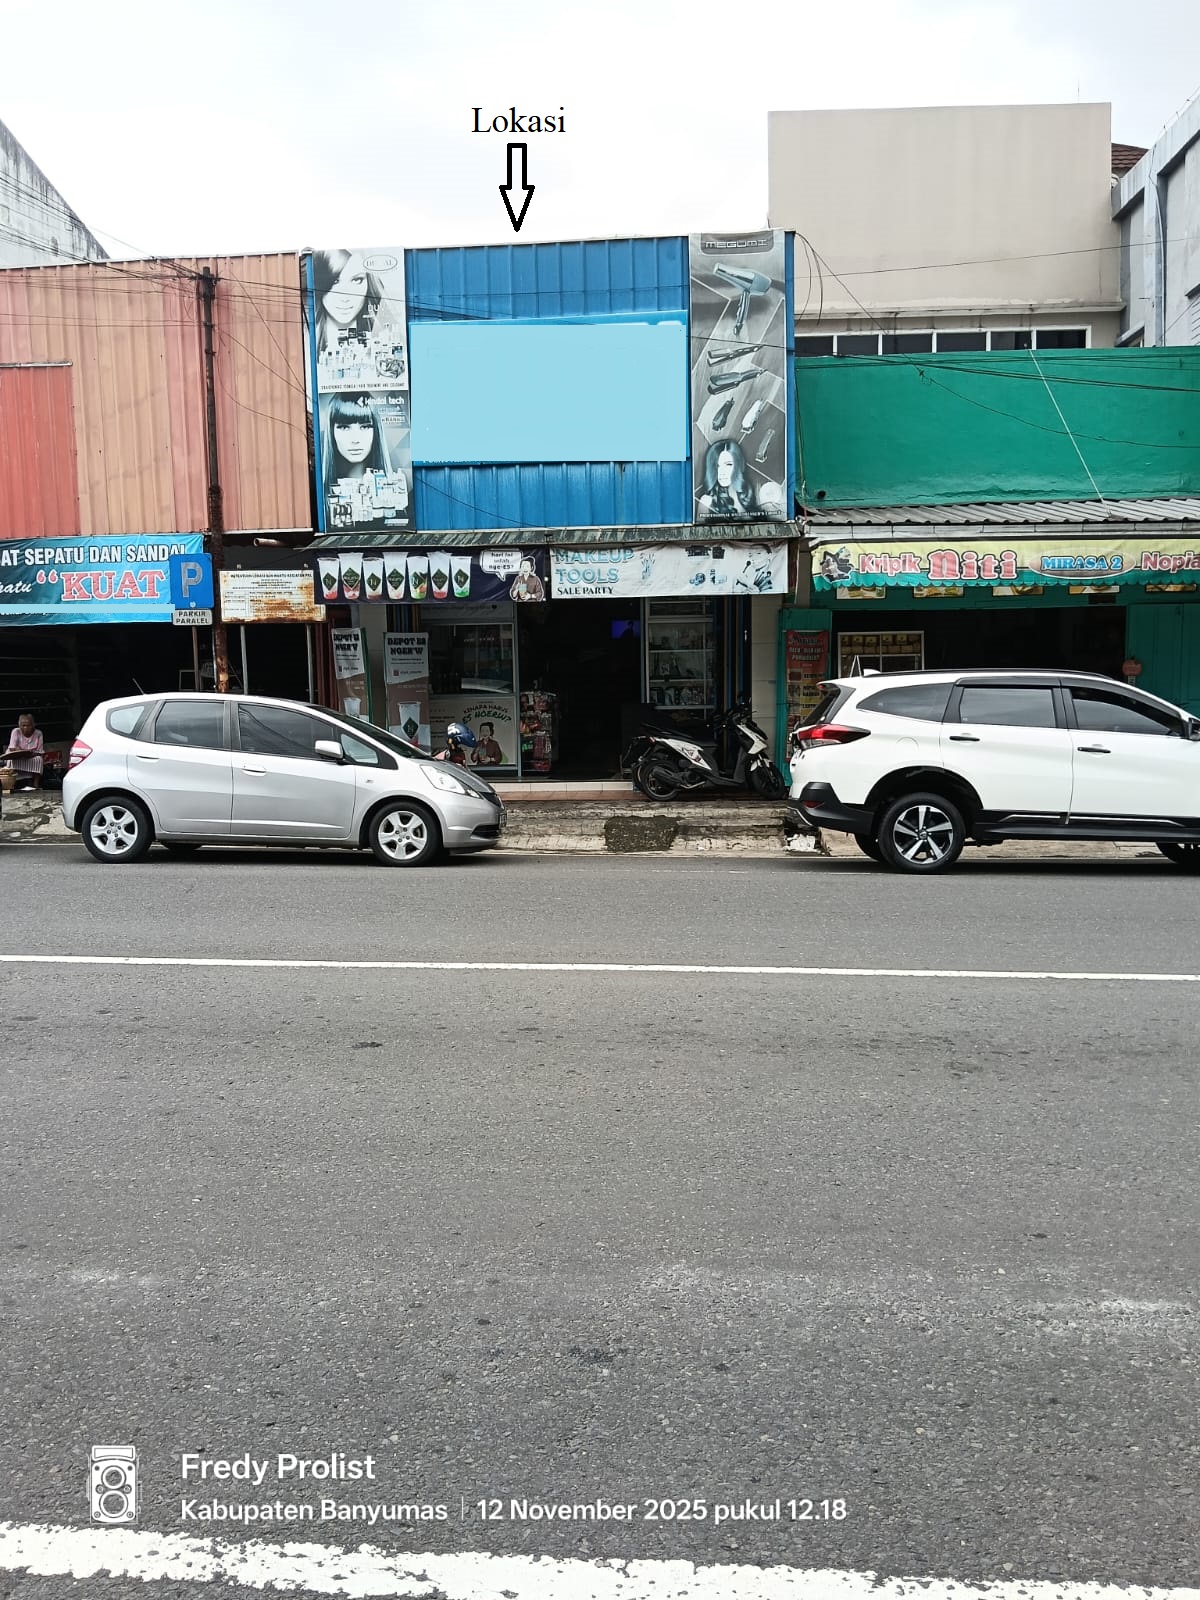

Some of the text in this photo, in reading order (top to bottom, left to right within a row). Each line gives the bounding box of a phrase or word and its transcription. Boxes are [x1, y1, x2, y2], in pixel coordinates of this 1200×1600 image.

[24, 546, 84, 566] SEPATU
[89, 545, 122, 563] DAN
[551, 547, 634, 564] MAKEUP
[859, 553, 922, 576] Kripik
[1040, 556, 1108, 571] MIRASA
[1110, 555, 1123, 570] 2
[181, 561, 203, 598] P
[555, 568, 619, 584] TOOLS
[557, 586, 613, 595] SALE PARTY
[178, 610, 206, 618] PARKIR
[387, 637, 415, 646] DEPOT
